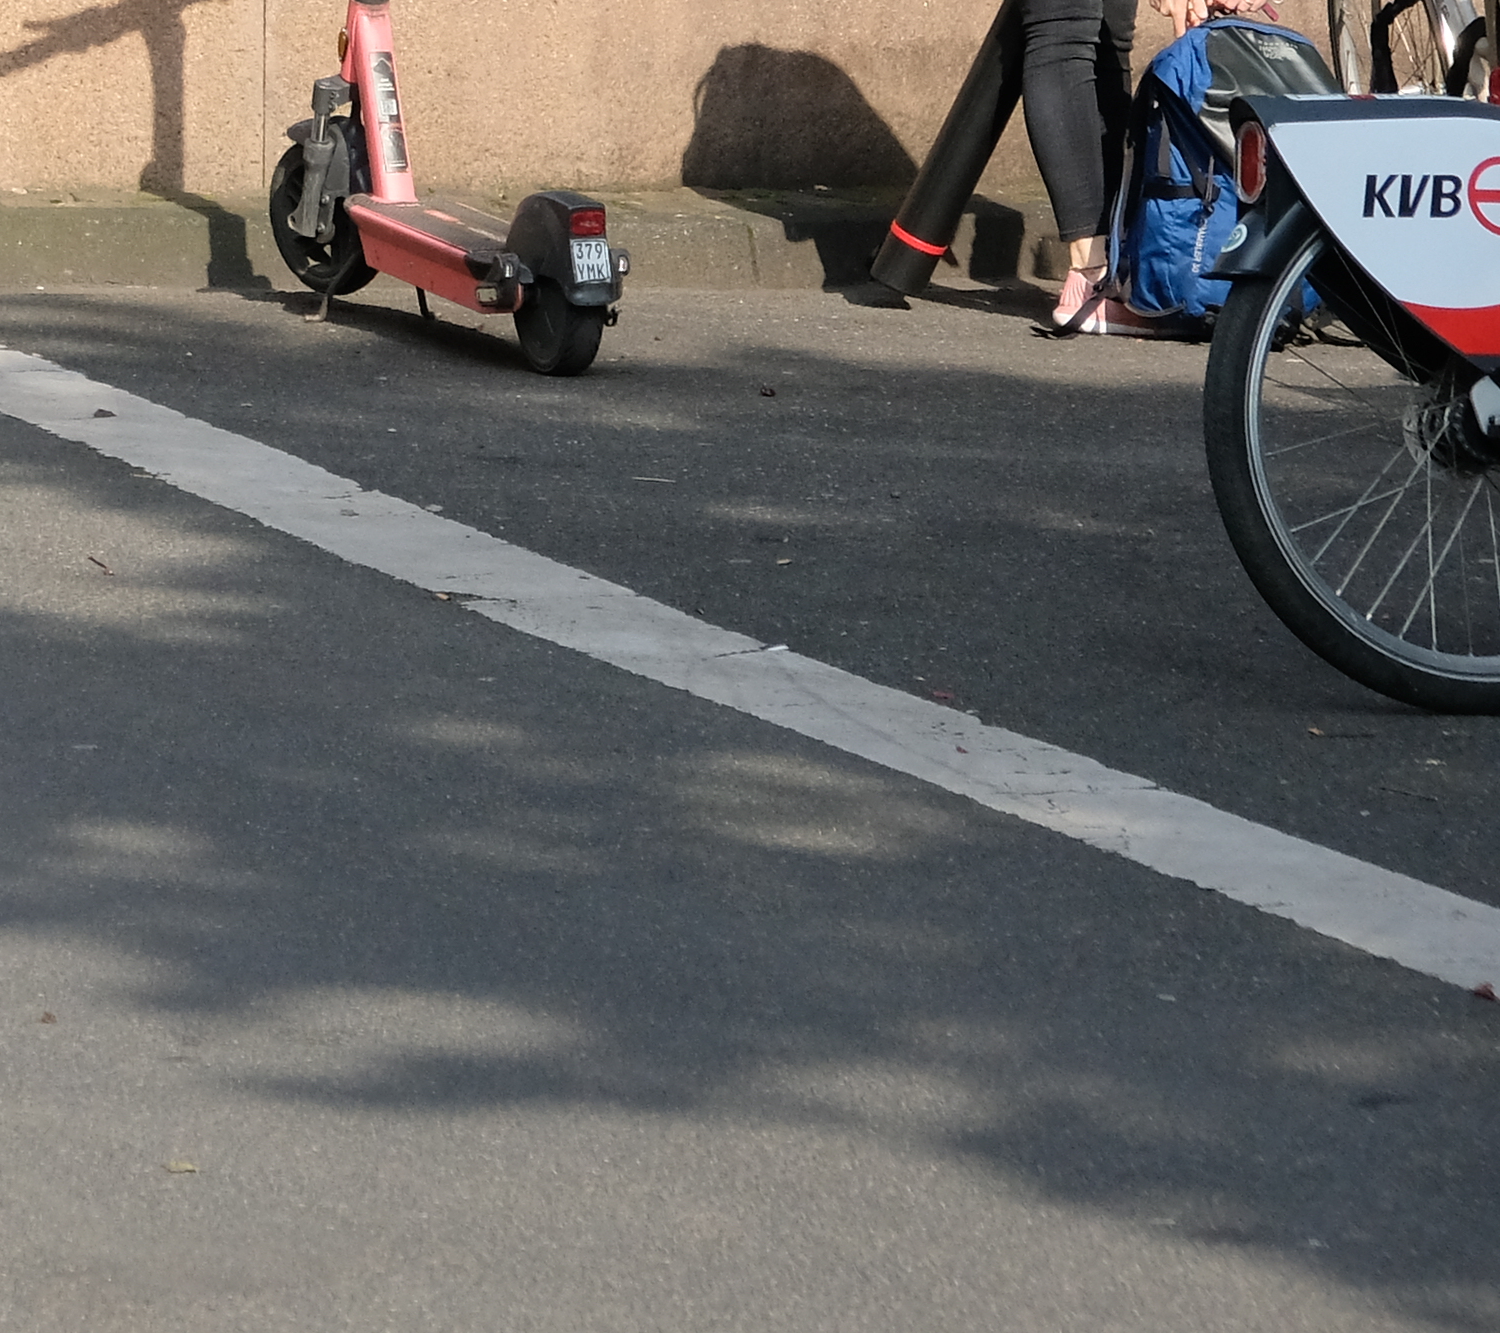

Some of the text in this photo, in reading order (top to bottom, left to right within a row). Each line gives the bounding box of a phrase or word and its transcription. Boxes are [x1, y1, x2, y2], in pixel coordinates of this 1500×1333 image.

[1362, 173, 1463, 218] KVB
[575, 243, 603, 260] 379
[576, 263, 606, 280] YMK
